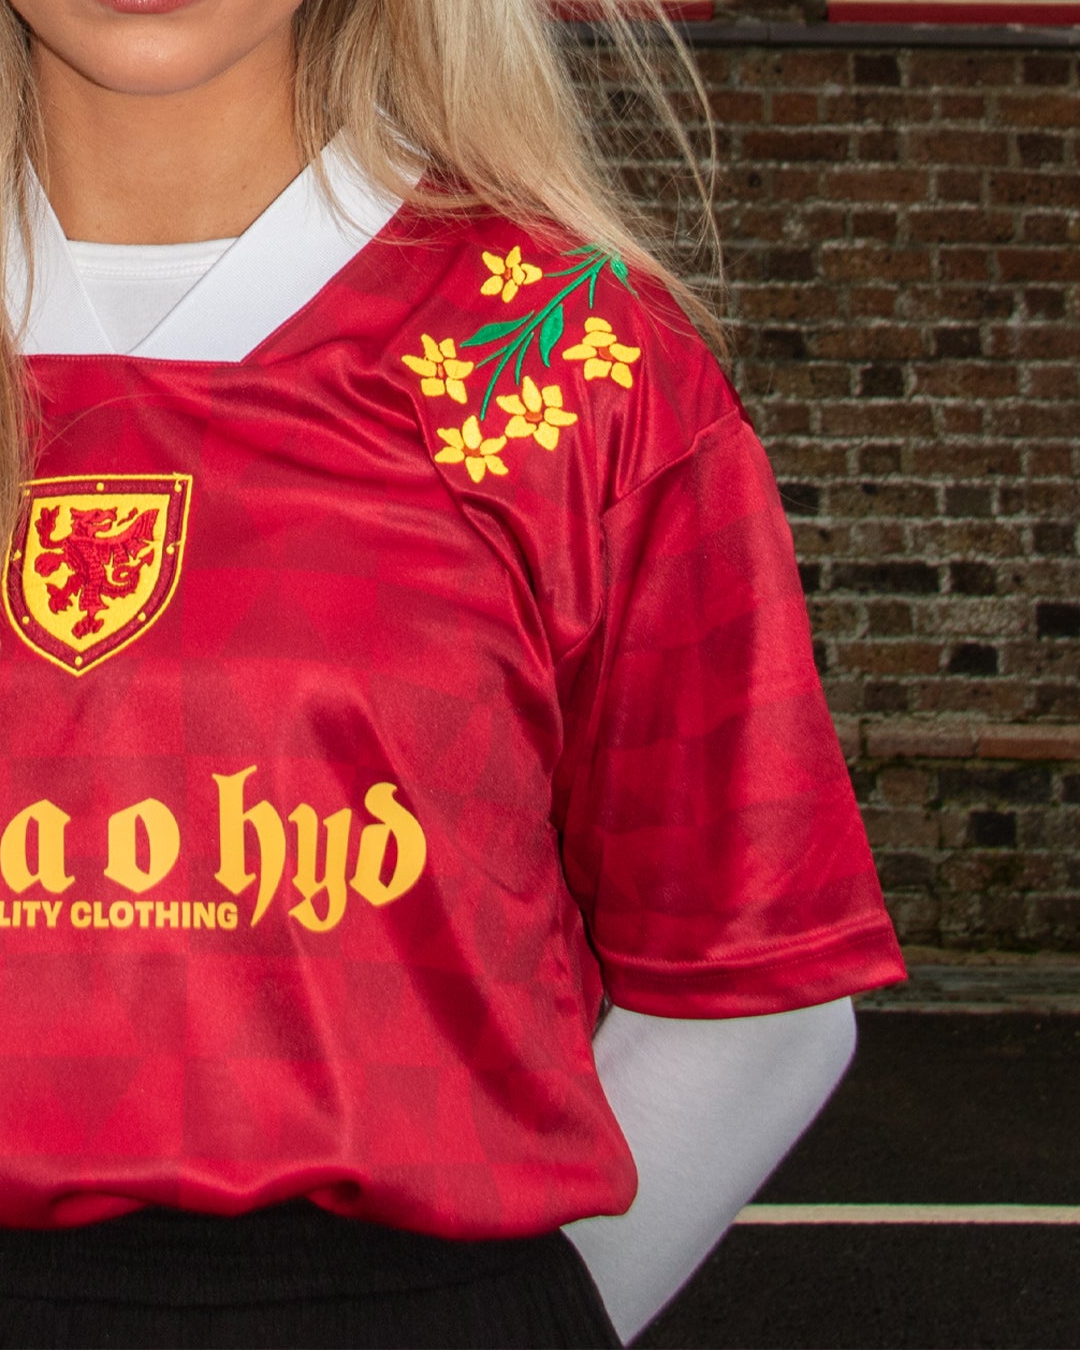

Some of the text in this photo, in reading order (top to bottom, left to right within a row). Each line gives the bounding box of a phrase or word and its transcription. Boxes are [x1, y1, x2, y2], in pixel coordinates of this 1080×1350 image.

[103, 797, 181, 894] o
[212, 764, 428, 933] hyd
[70, 900, 238, 929] CLOTHING
